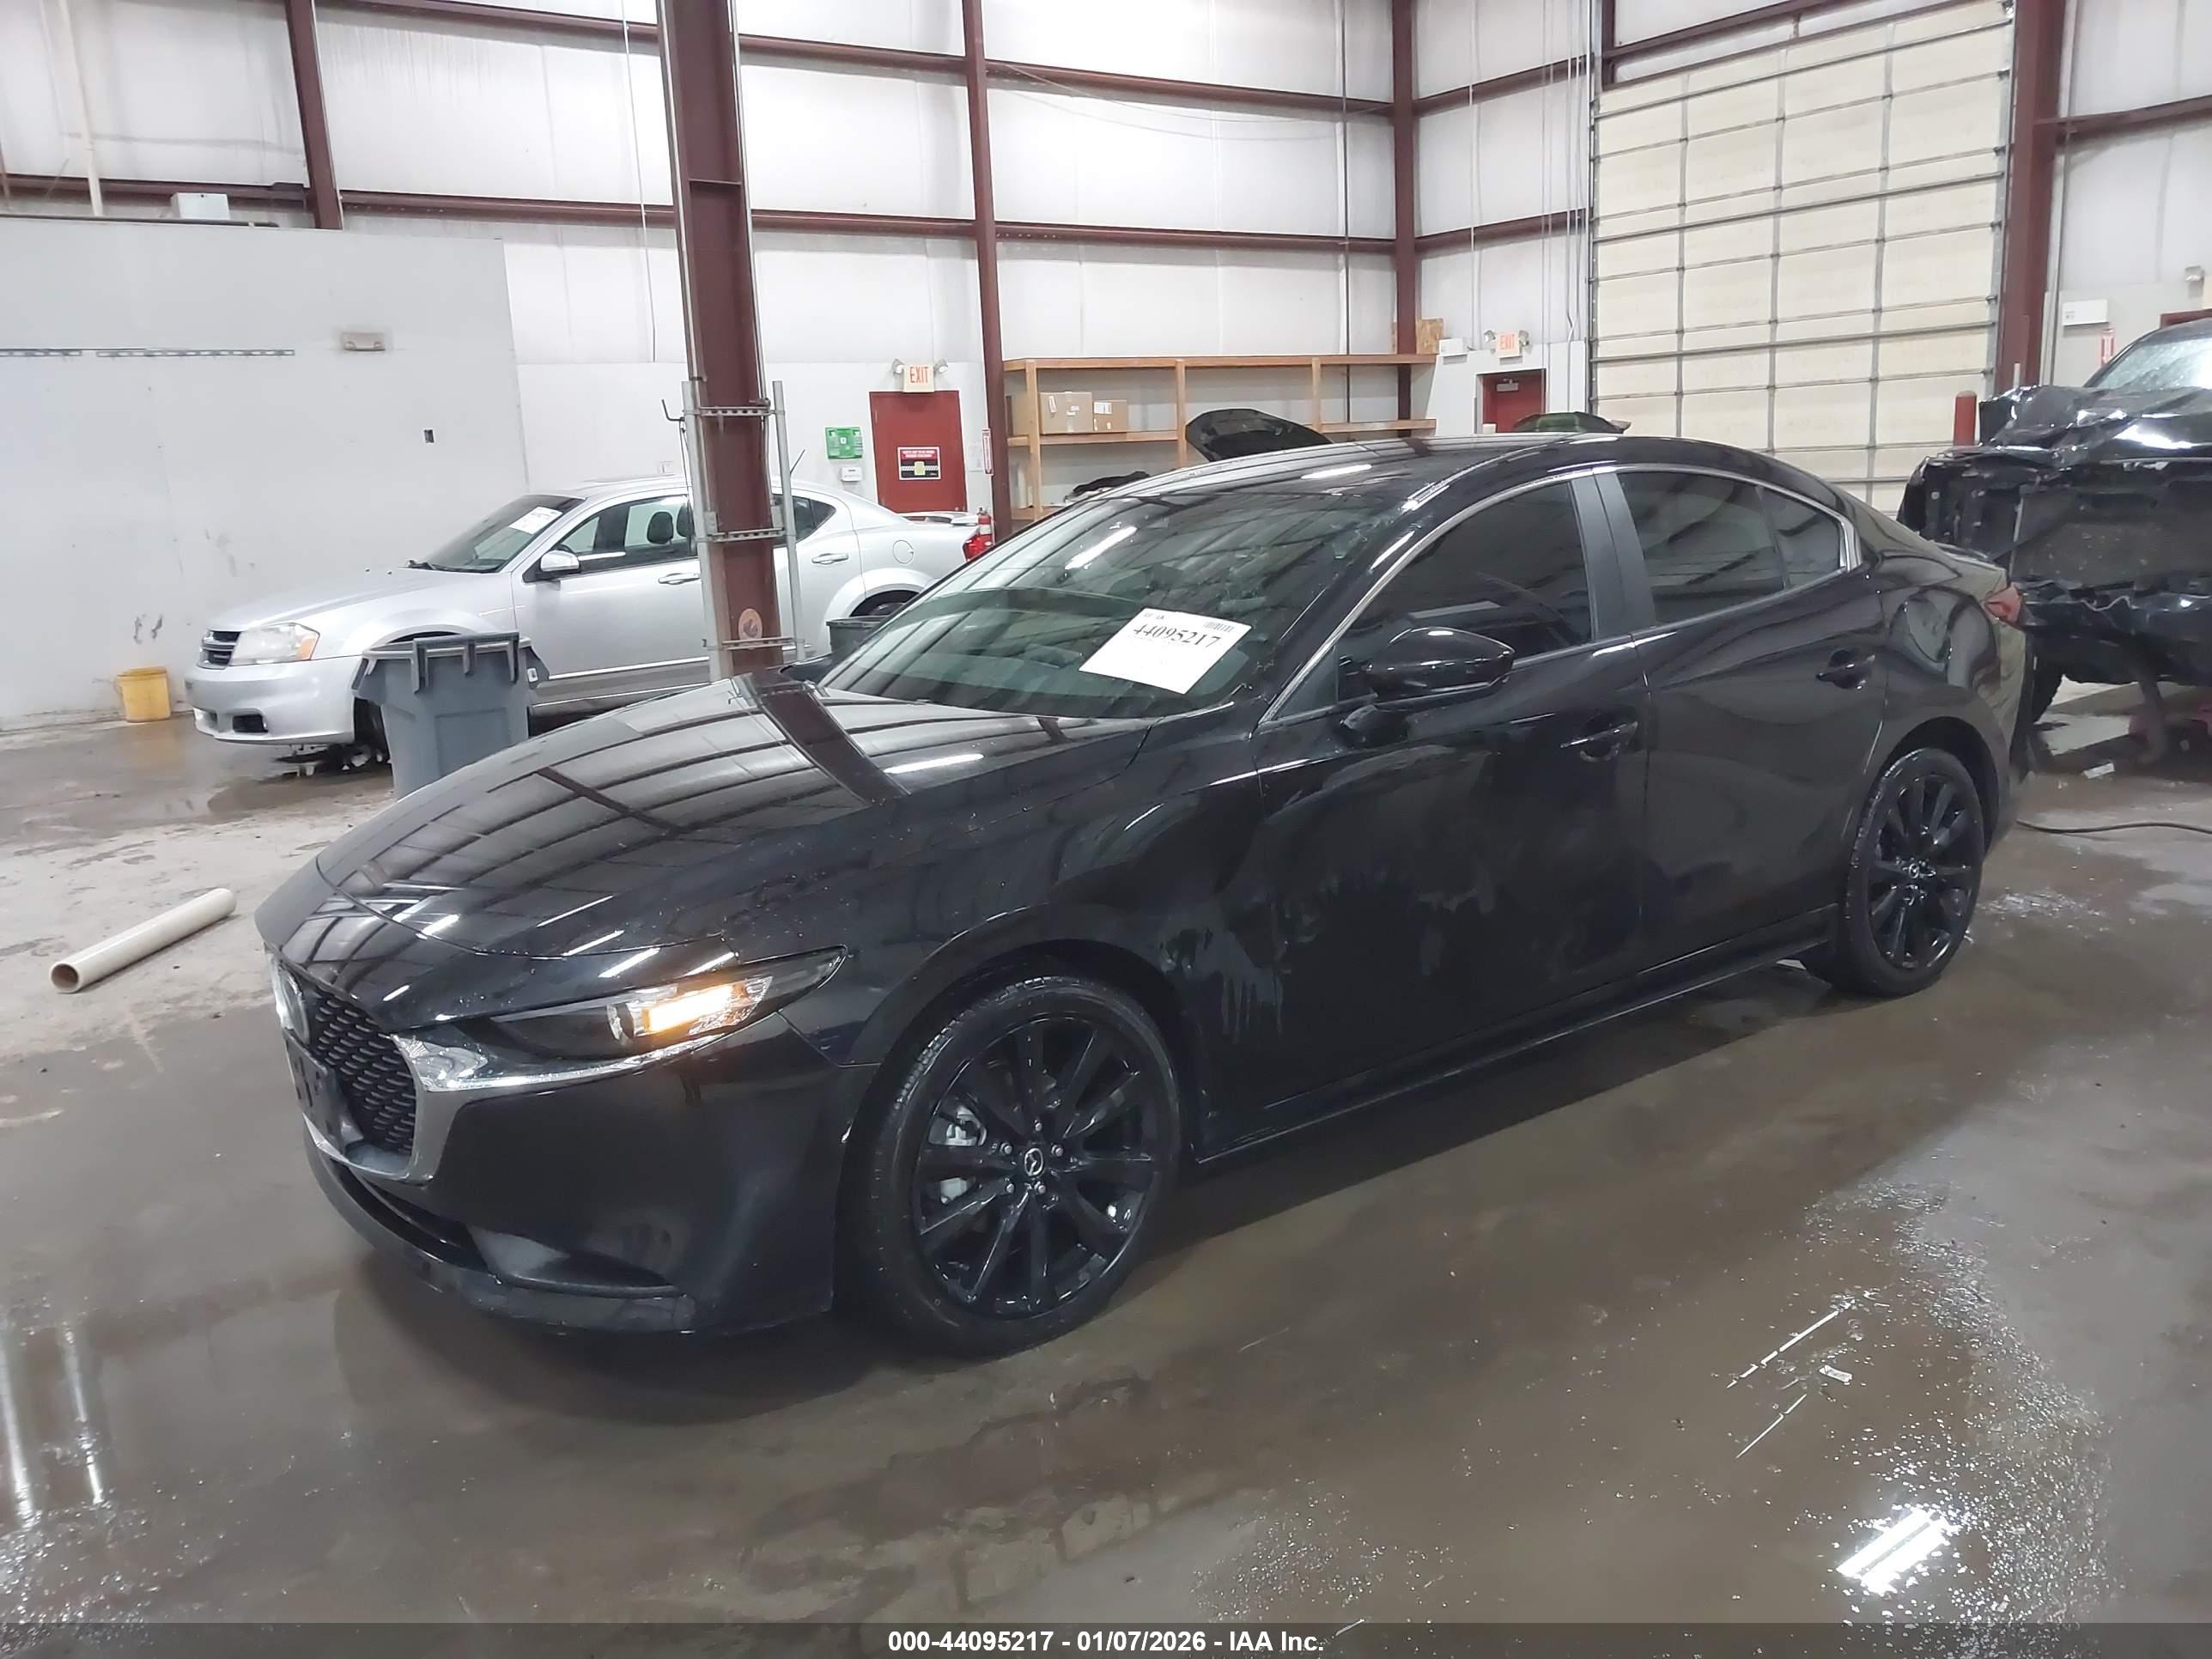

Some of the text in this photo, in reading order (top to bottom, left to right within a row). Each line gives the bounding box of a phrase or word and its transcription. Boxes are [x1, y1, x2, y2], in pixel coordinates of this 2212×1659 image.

[1500, 333, 1516, 350] EXIT
[909, 366, 928, 384] EXIT
[1133, 623, 1221, 647] 44095217
